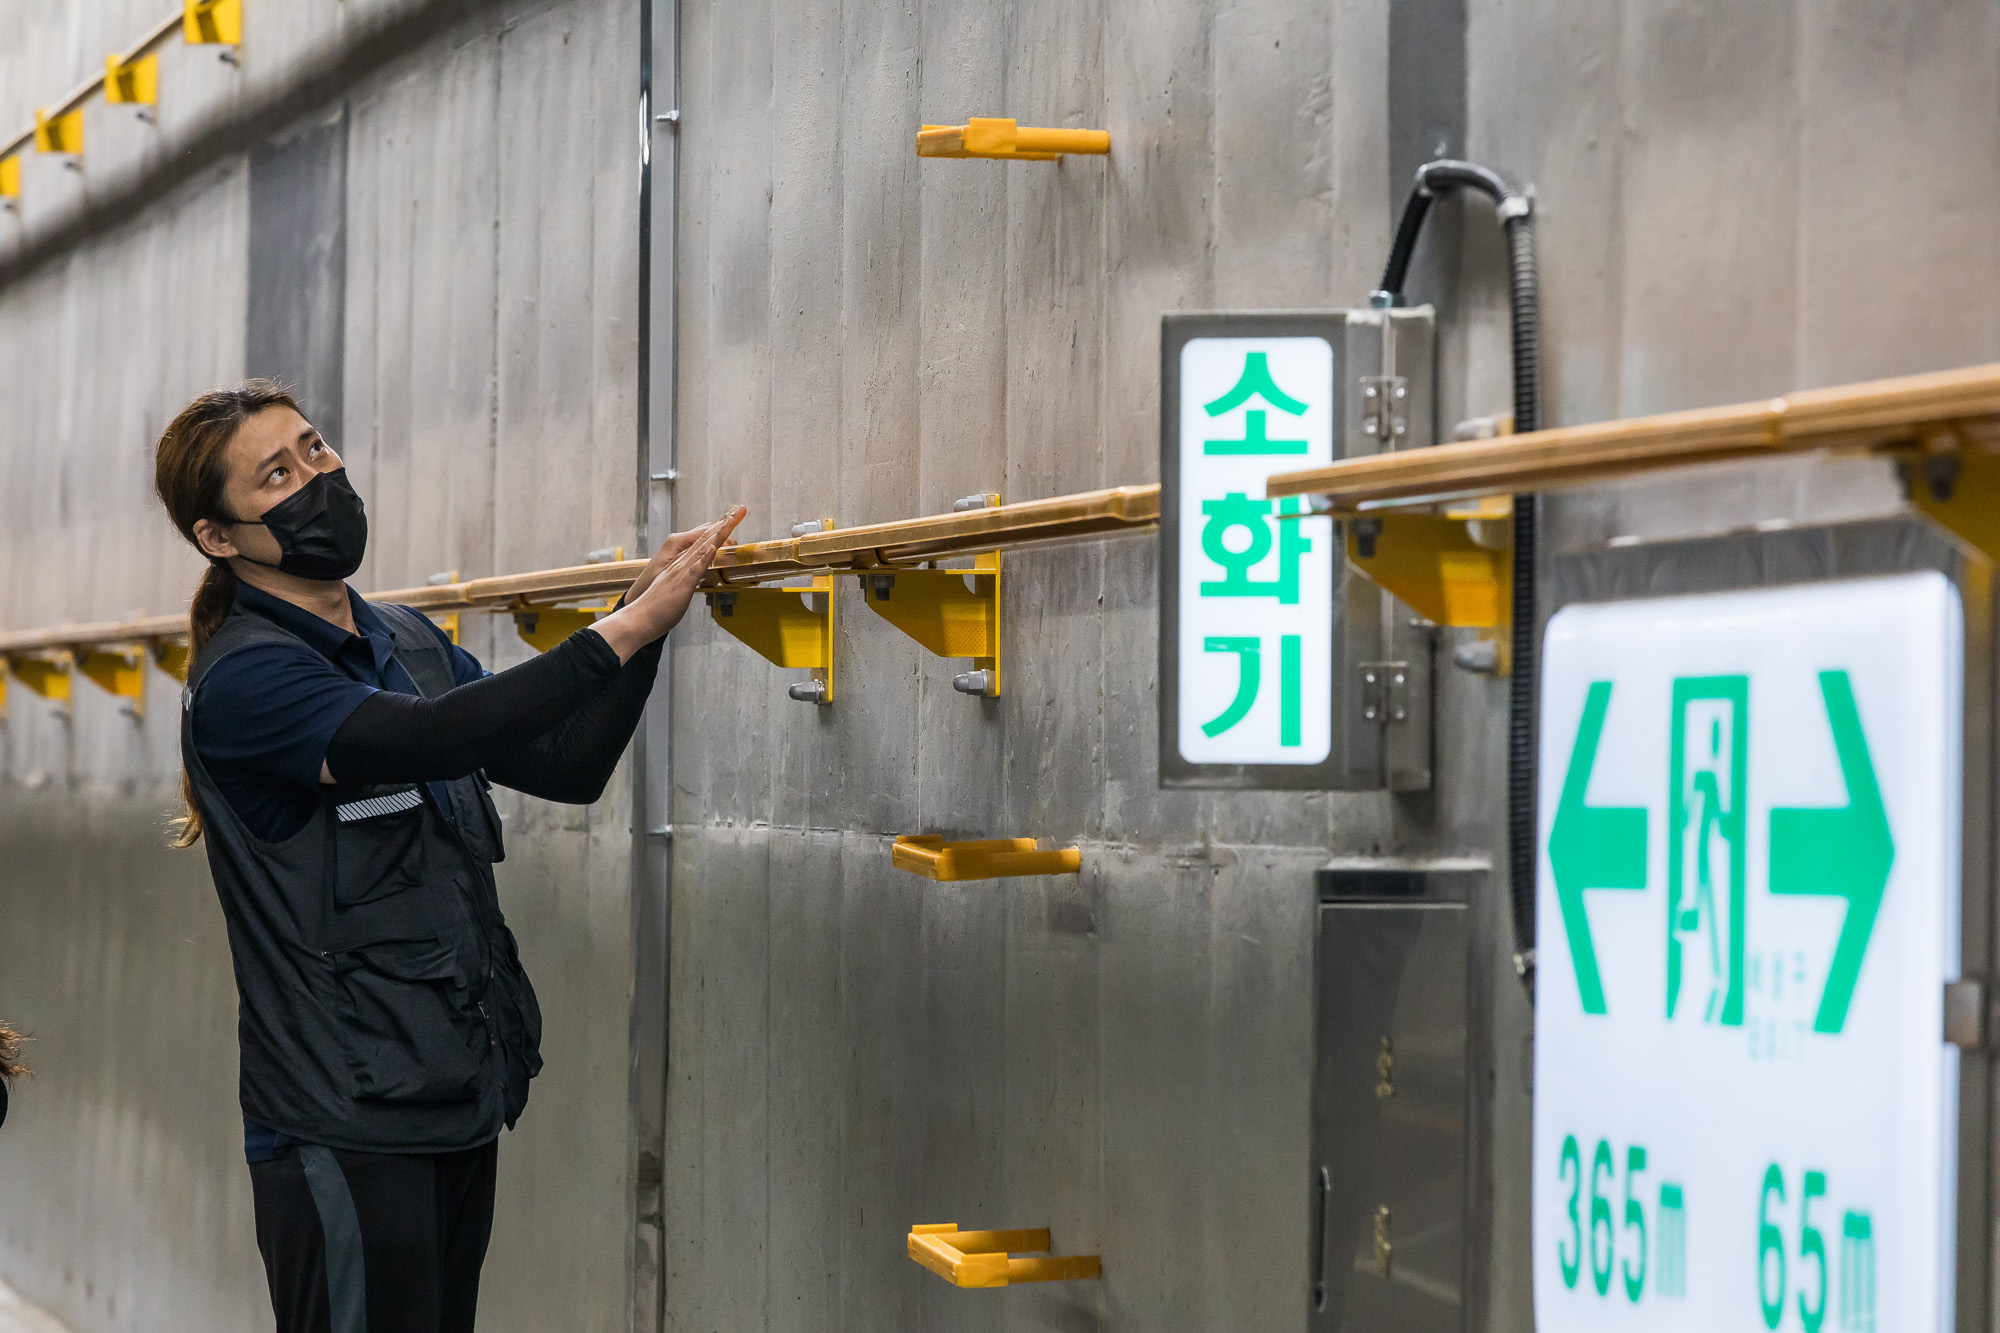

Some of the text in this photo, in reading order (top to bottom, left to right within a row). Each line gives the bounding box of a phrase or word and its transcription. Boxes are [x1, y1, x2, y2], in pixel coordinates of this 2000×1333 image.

[1200, 352, 1312, 748] 소화기
[1558, 1133, 1687, 1304] 365m
[1758, 1162, 1876, 1333] 65m
